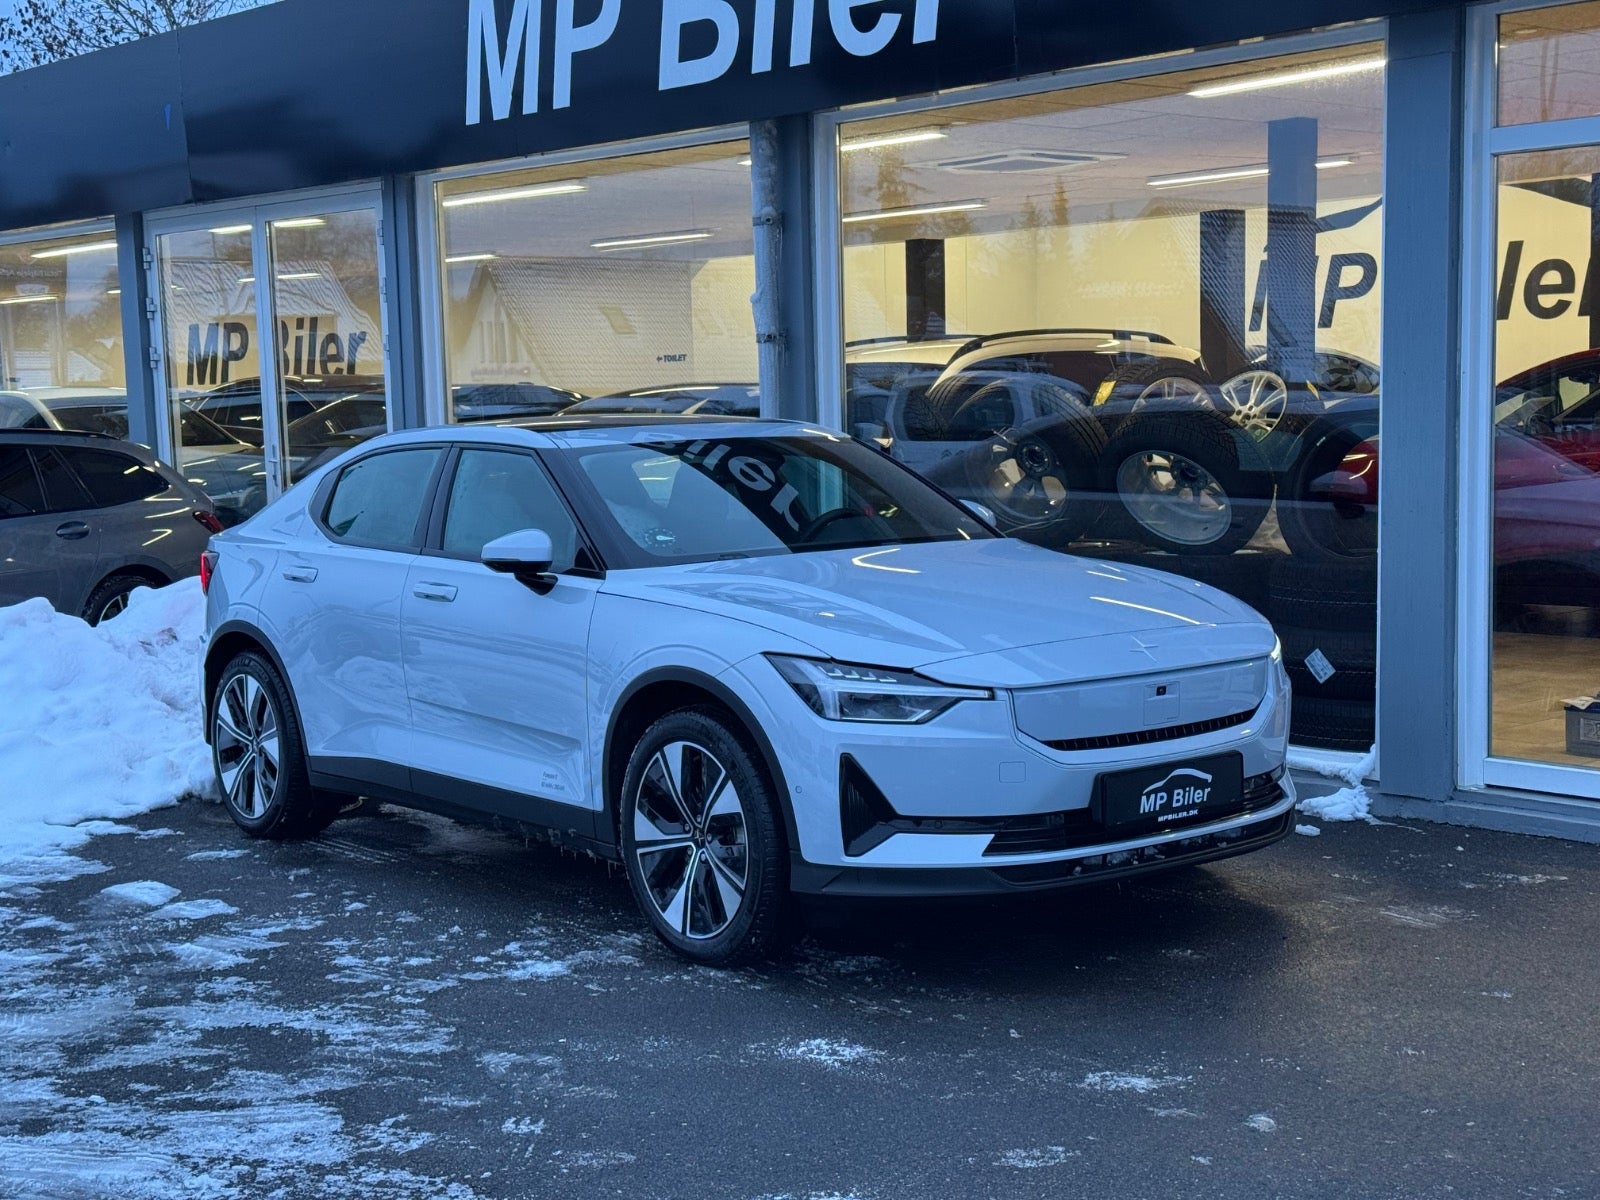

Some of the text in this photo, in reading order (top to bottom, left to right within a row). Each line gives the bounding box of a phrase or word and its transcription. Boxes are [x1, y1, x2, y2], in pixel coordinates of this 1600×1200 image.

[465, 0, 622, 126] MP
[186, 322, 249, 386] MP
[663, 353, 687, 363] TOILET
[1139, 786, 1211, 814] MP Biler
[1157, 808, 1199, 823] MPBILER.DK
